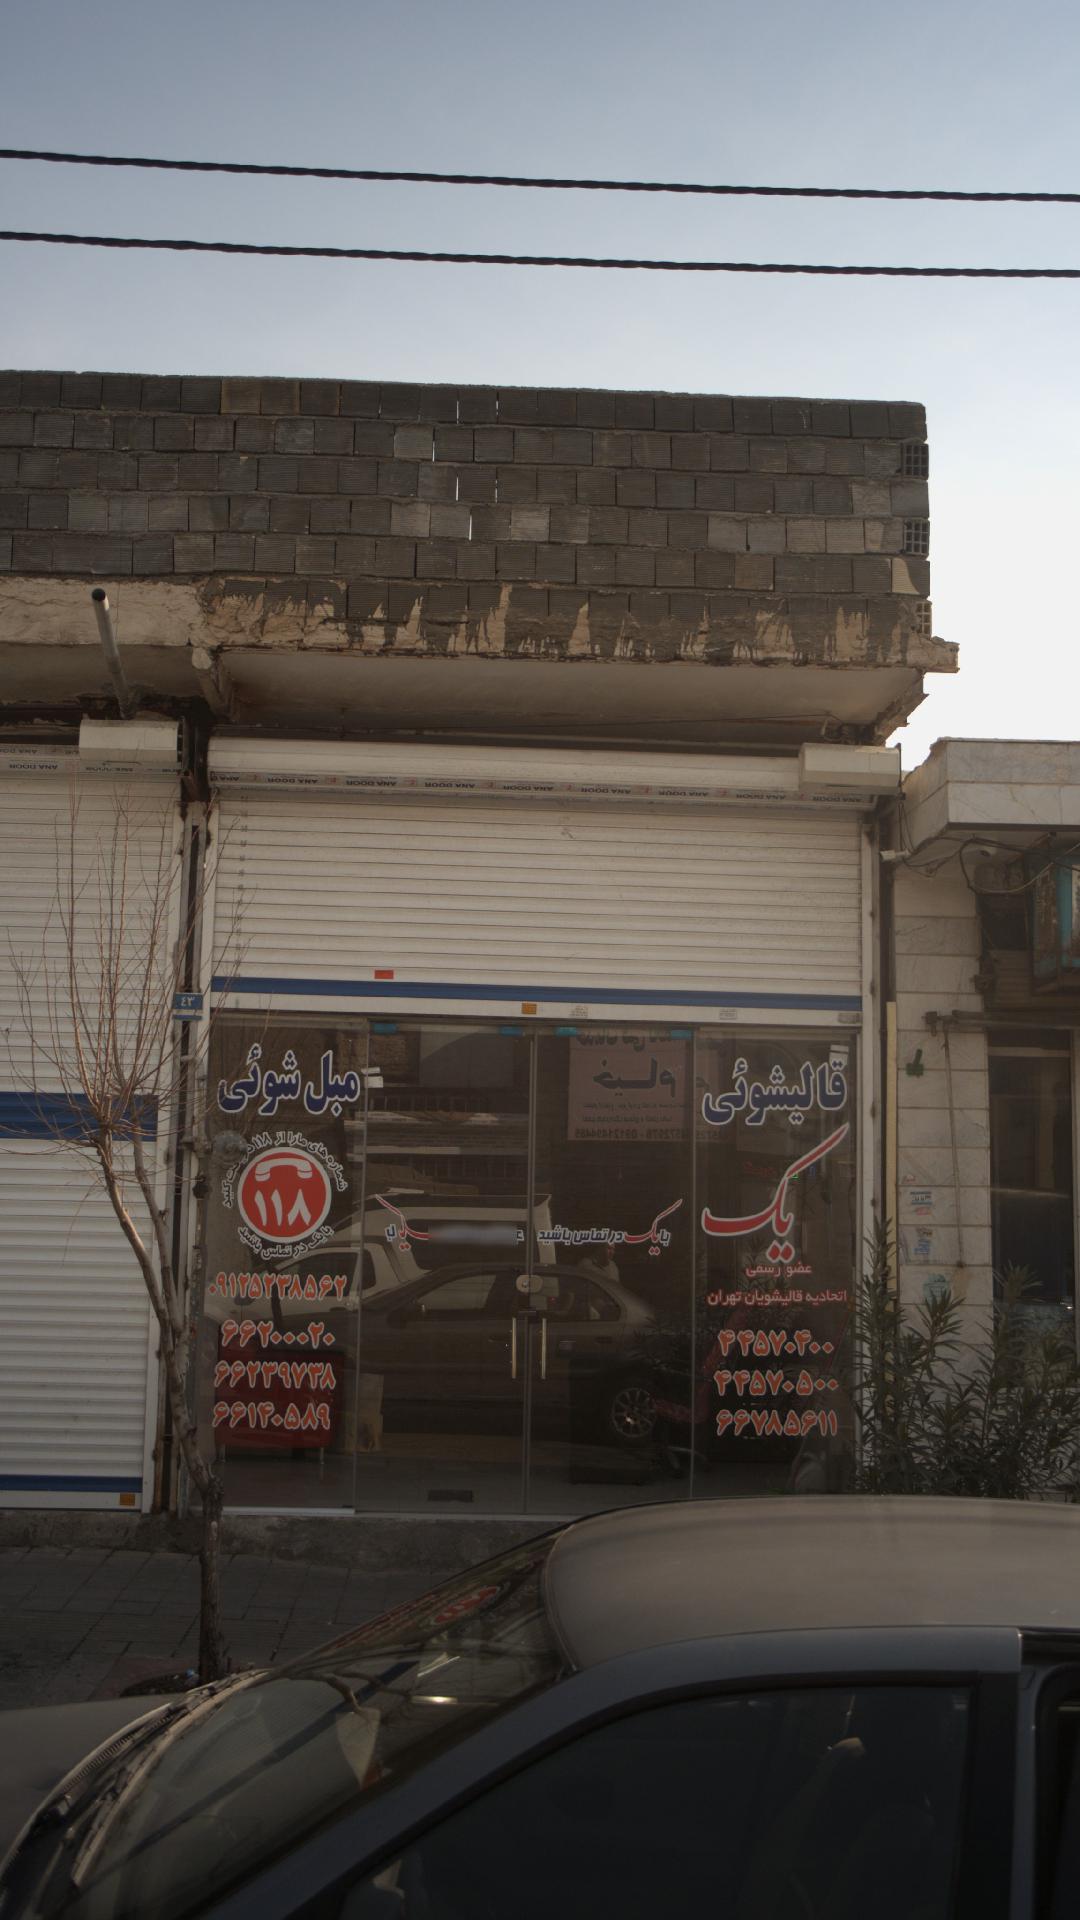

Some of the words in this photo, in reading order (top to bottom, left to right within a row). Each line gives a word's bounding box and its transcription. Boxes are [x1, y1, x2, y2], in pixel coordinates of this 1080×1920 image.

[304, 1049, 361, 1117] مبل
[702, 1057, 848, 1126] قالیشوئی
[275, 1131, 287, 1146] از
[326, 1154, 349, 1192] شماره
[701, 1122, 850, 1264] یک
[254, 1188, 312, 1228] ۱۱۸
[320, 1225, 334, 1239] با
[537, 1224, 572, 1246] باشید
[573, 1227, 609, 1246] تماس
[608, 1229, 624, 1246] در
[623, 1198, 684, 1257] یک
[659, 1228, 671, 1247] با
[238, 1225, 262, 1254] باشید
[262, 1244, 292, 1261] تماس
[294, 1242, 308, 1258] در
[745, 1263, 782, 1279] رسمی
[785, 1260, 813, 1279] عضو
[706, 1289, 742, 1307] تهران
[744, 1289, 803, 1308] قالیشویان
[806, 1289, 848, 1307] اتحادیه
[718, 1328, 835, 1357] ۴۴۵۷۰۴۰۰
[714, 1369, 840, 1397] ۴۴۵۷۰۵۰۰
[212, 1400, 331, 1431] ۶۶۱۴۰۵۸۹
[716, 1408, 838, 1437] ۶۶۷۸۵۶۱۱
